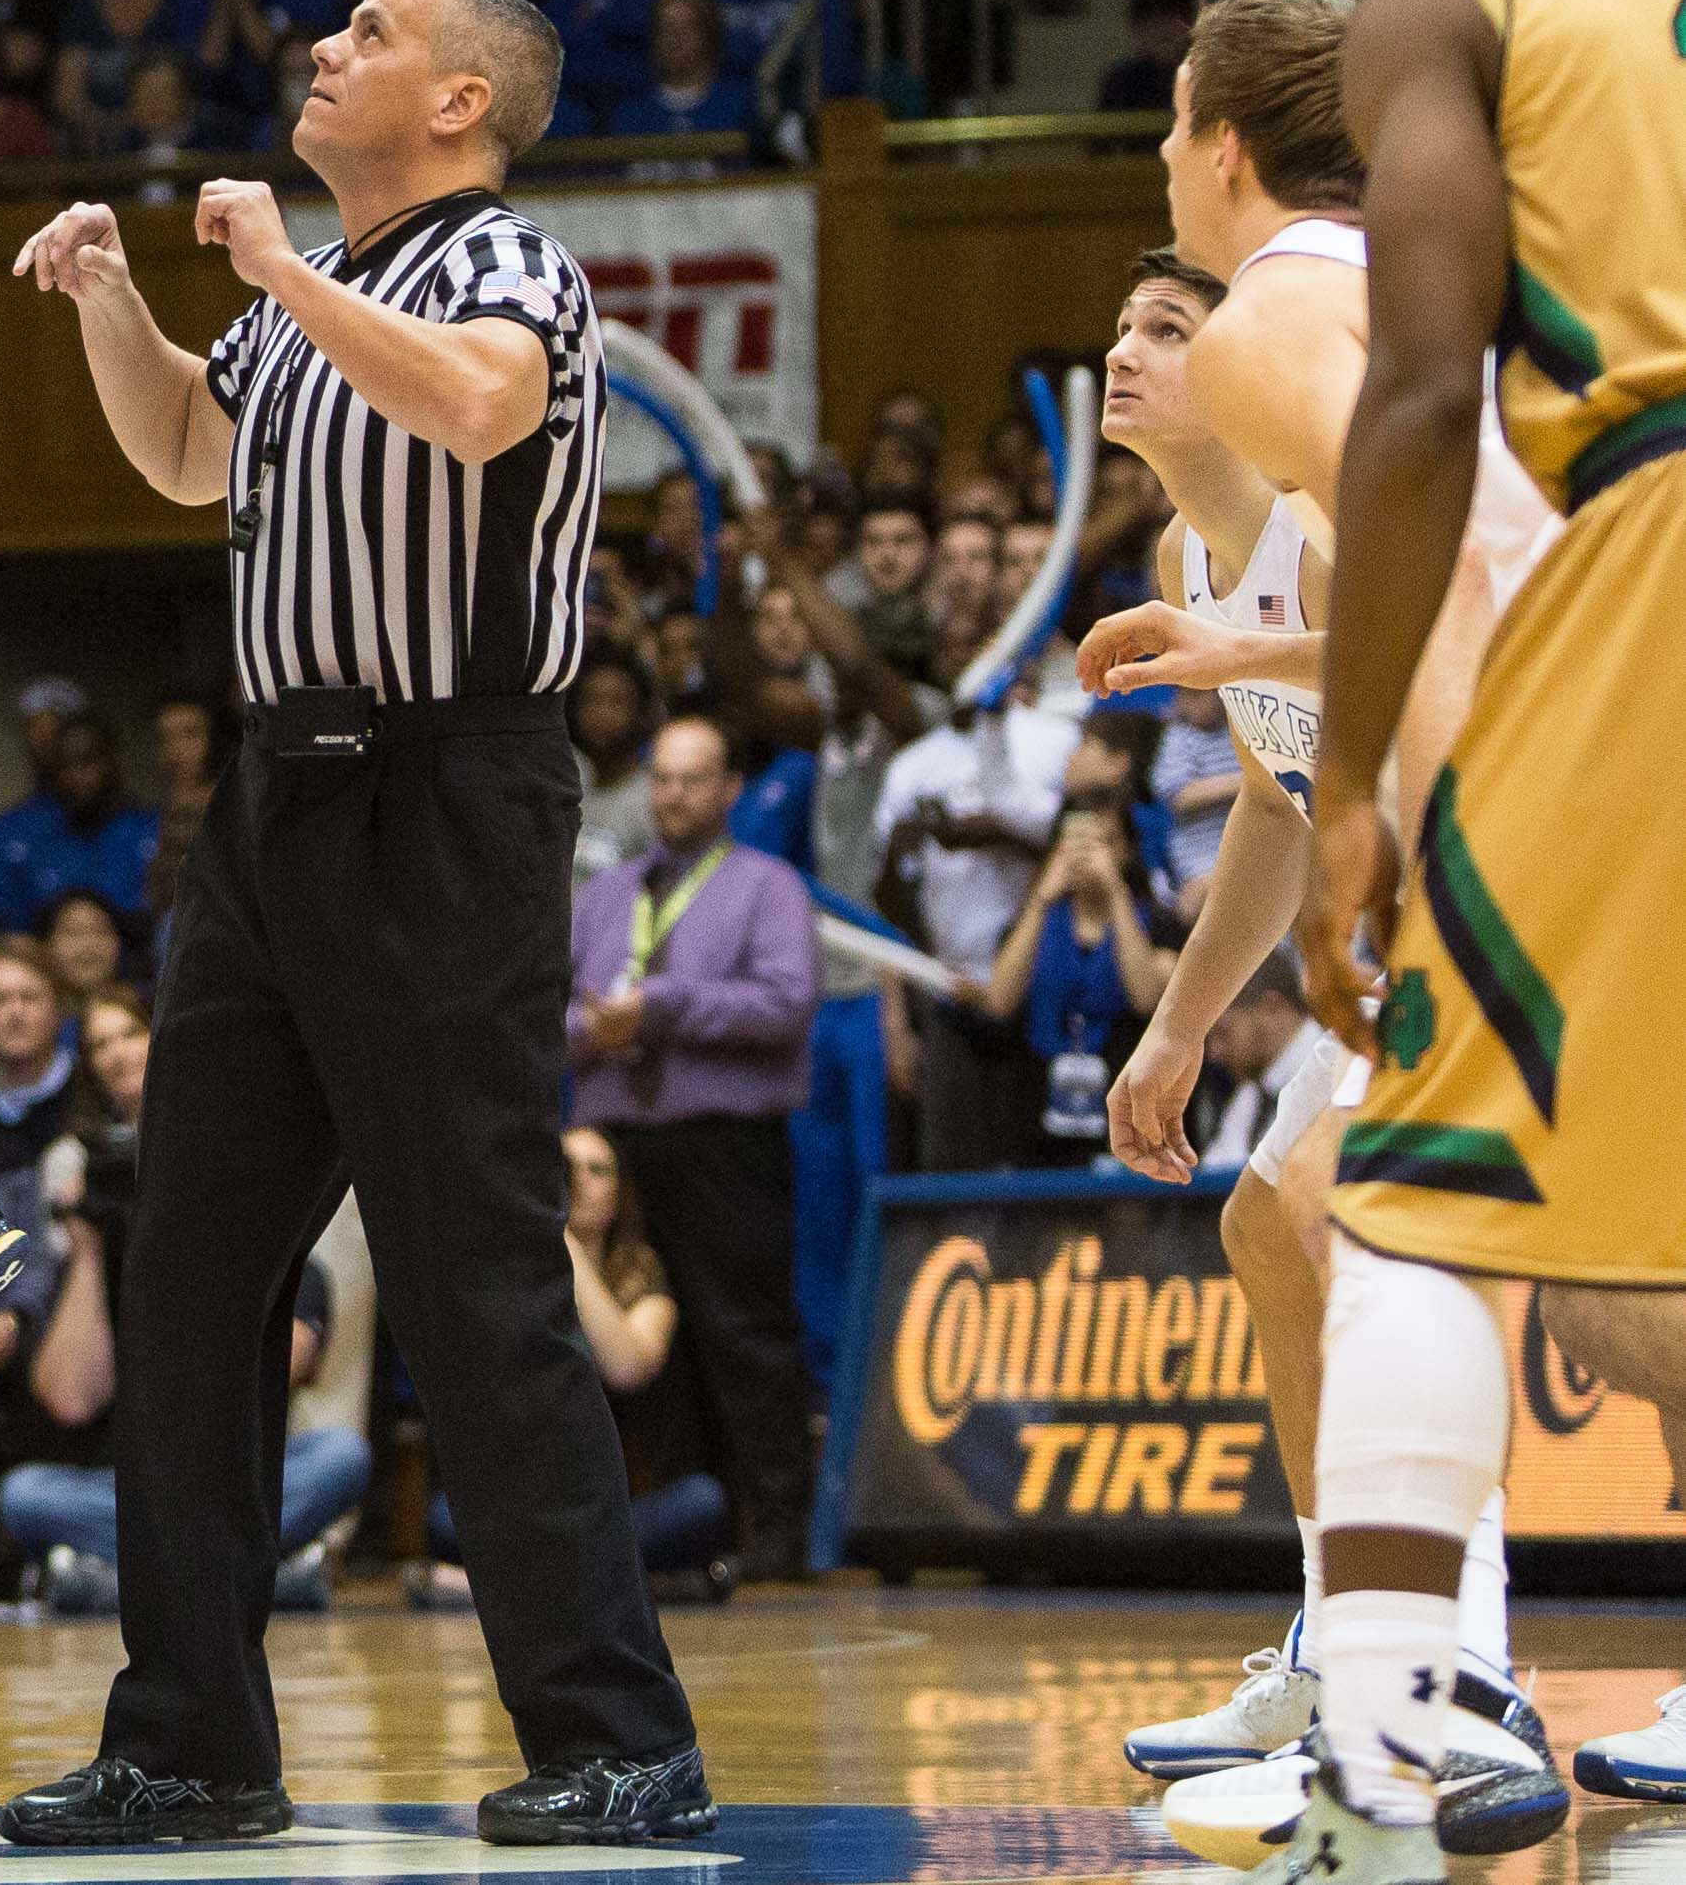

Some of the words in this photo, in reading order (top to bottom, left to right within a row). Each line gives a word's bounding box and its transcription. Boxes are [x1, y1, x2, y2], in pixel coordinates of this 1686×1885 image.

[1225, 686, 1319, 765] UKE
[894, 1234, 1267, 1443] Continen
[1014, 1422, 1265, 1514] TIRE
